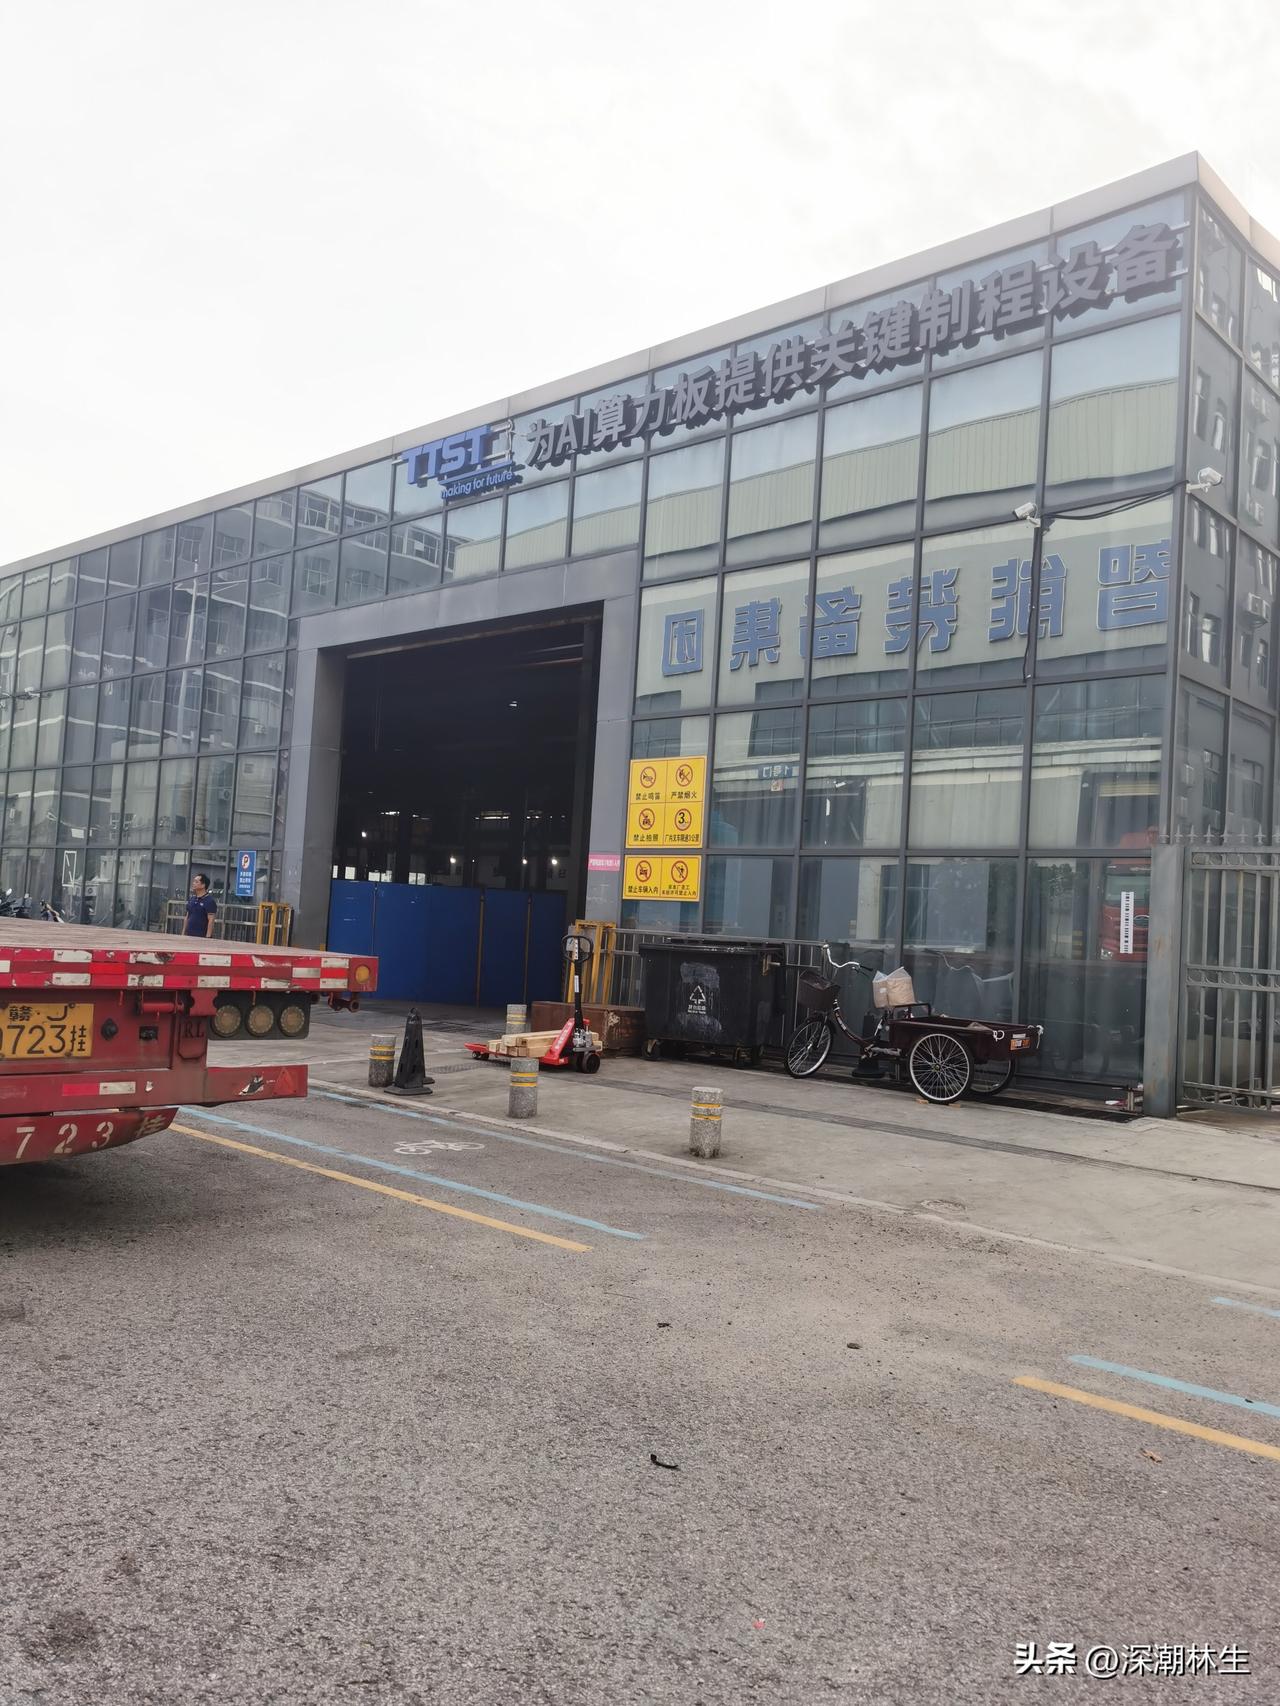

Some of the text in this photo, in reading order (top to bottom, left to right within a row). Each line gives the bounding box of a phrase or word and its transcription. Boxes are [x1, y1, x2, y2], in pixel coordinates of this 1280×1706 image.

[525, 224, 1176, 466] 为AI算力板提供关键制程设备
[402, 425, 491, 484] TTST
[441, 469, 513, 499] making for future
[635, 793, 661, 801] 禁止鸣笛
[671, 791, 697, 800] 严禁烟火
[0, 1024, 87, 1055] 723挂
